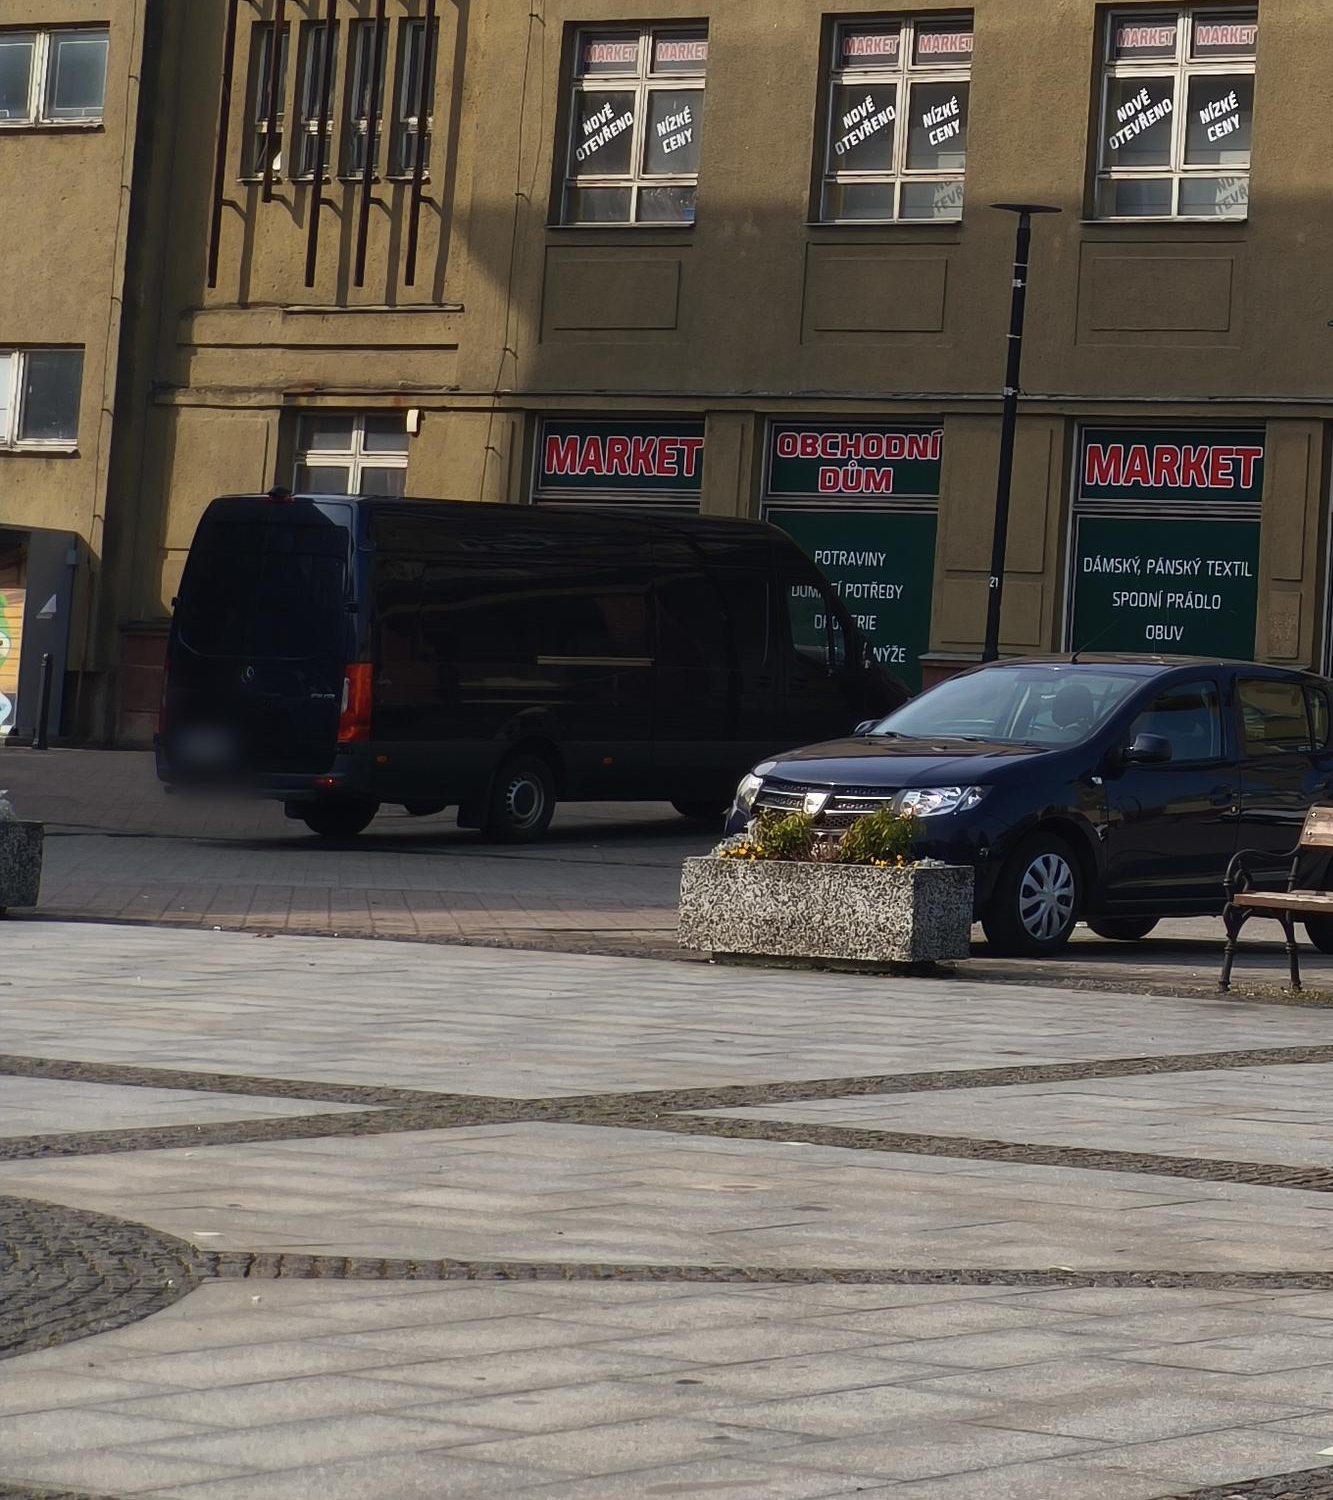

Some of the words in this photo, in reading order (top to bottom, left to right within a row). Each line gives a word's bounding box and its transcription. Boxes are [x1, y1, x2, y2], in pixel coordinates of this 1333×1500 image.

[844, 35, 899, 55] MARKET
[919, 34, 974, 53] MARKET
[1117, 26, 1176, 47] MARKET
[1197, 25, 1258, 45] MARKET
[584, 44, 638, 62] MARKET
[582, 102, 614, 135] NOVĚ
[843, 95, 875, 128] NOVĚ
[922, 96, 959, 128] NÍZKÉ
[1117, 88, 1150, 122] NOVĚ
[1200, 91, 1238, 124] NÍZKÉ
[657, 105, 692, 136] NÍZKÉ
[835, 106, 896, 155] OTEVŘENO
[929, 119, 960, 145] CENY
[1109, 99, 1172, 149] OTEVŘENO
[1208, 114, 1239, 141] CENY
[576, 111, 634, 161] OTEVŘENO
[662, 128, 692, 153] CENY
[544, 435, 704, 476] MARKET
[777, 430, 943, 460] OBCHODNÍ
[819, 460, 893, 493] DŮM
[1084, 443, 1263, 489] MARKET
[815, 551, 886, 567] POTRAVINY
[1083, 555, 1141, 576] DÁMSKÝ,
[1147, 557, 1201, 575] PÁNSKÝ
[1207, 560, 1252, 577] TEXTIL
[846, 581, 903, 599] POTŘEBY
[989, 576, 998, 588] 21
[1113, 590, 1163, 609] SPODNÍ
[1167, 591, 1221, 610] PRÁDLO
[1146, 625, 1184, 640] OBUV
